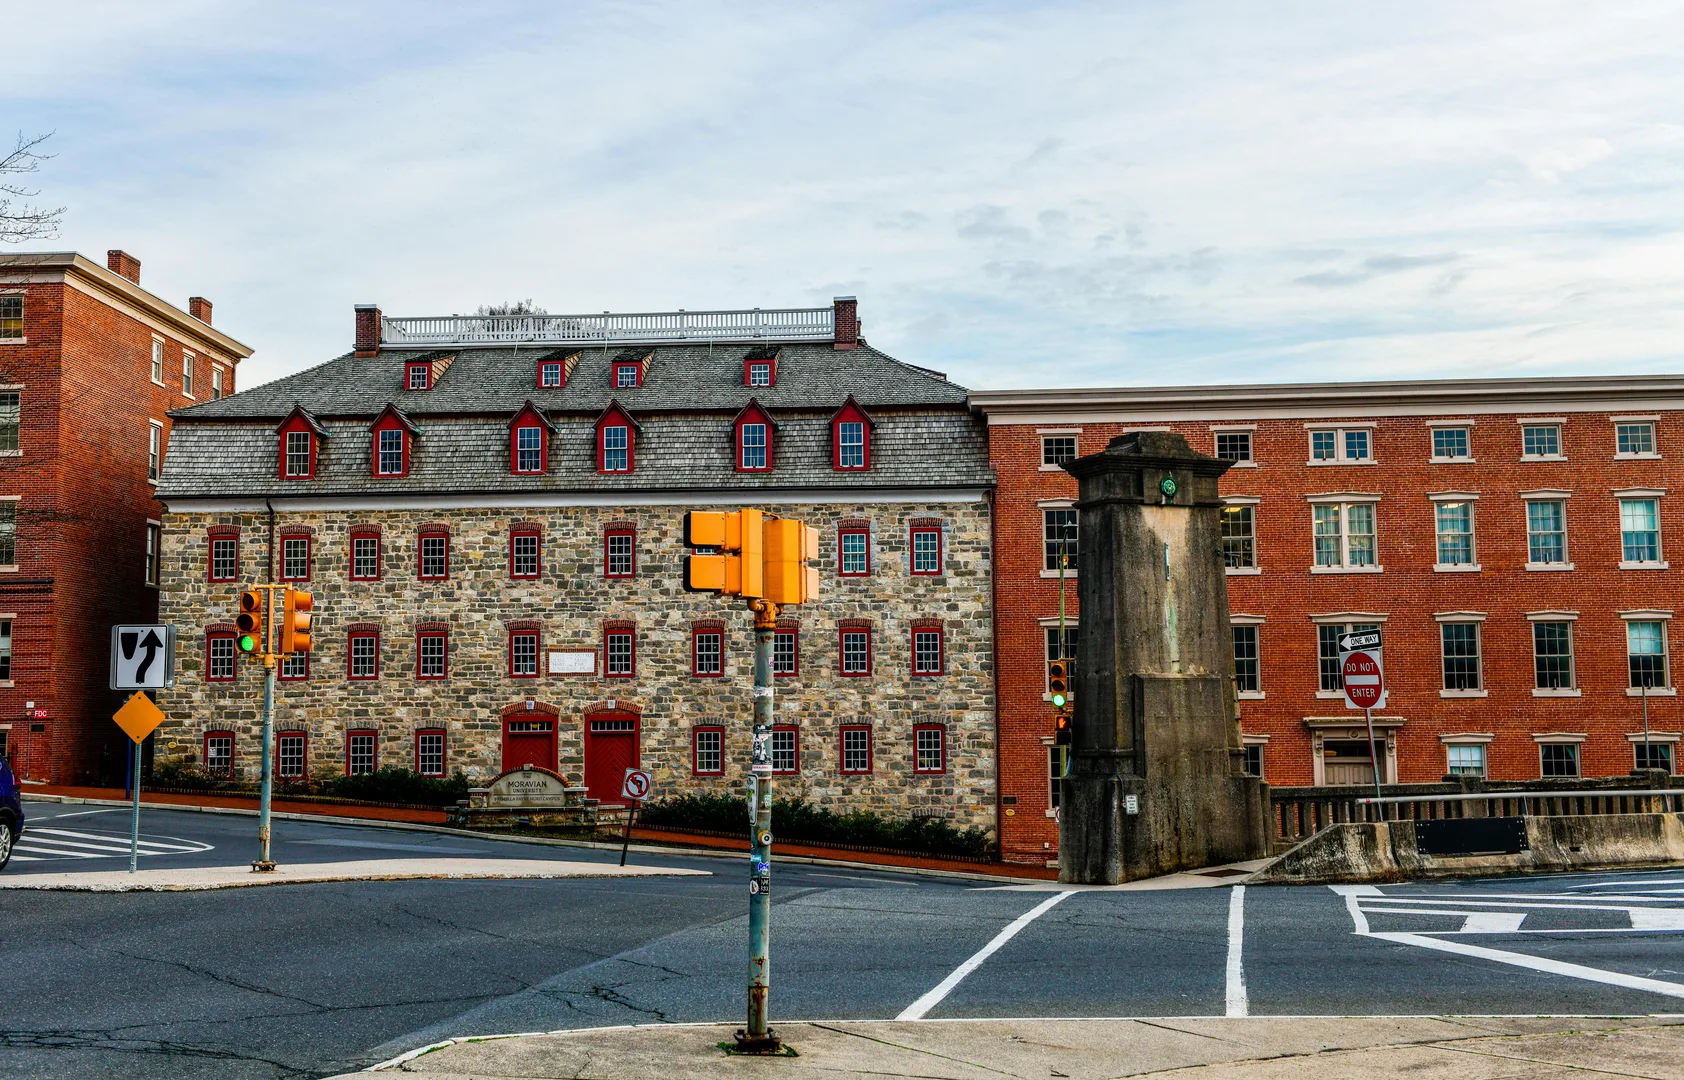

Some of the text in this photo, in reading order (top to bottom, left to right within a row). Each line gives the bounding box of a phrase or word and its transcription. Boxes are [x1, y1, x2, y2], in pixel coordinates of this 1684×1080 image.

[1350, 635, 1376, 646] ONE WAY
[1346, 662, 1374, 672] DO NOT
[1352, 688, 1376, 698] ENTER
